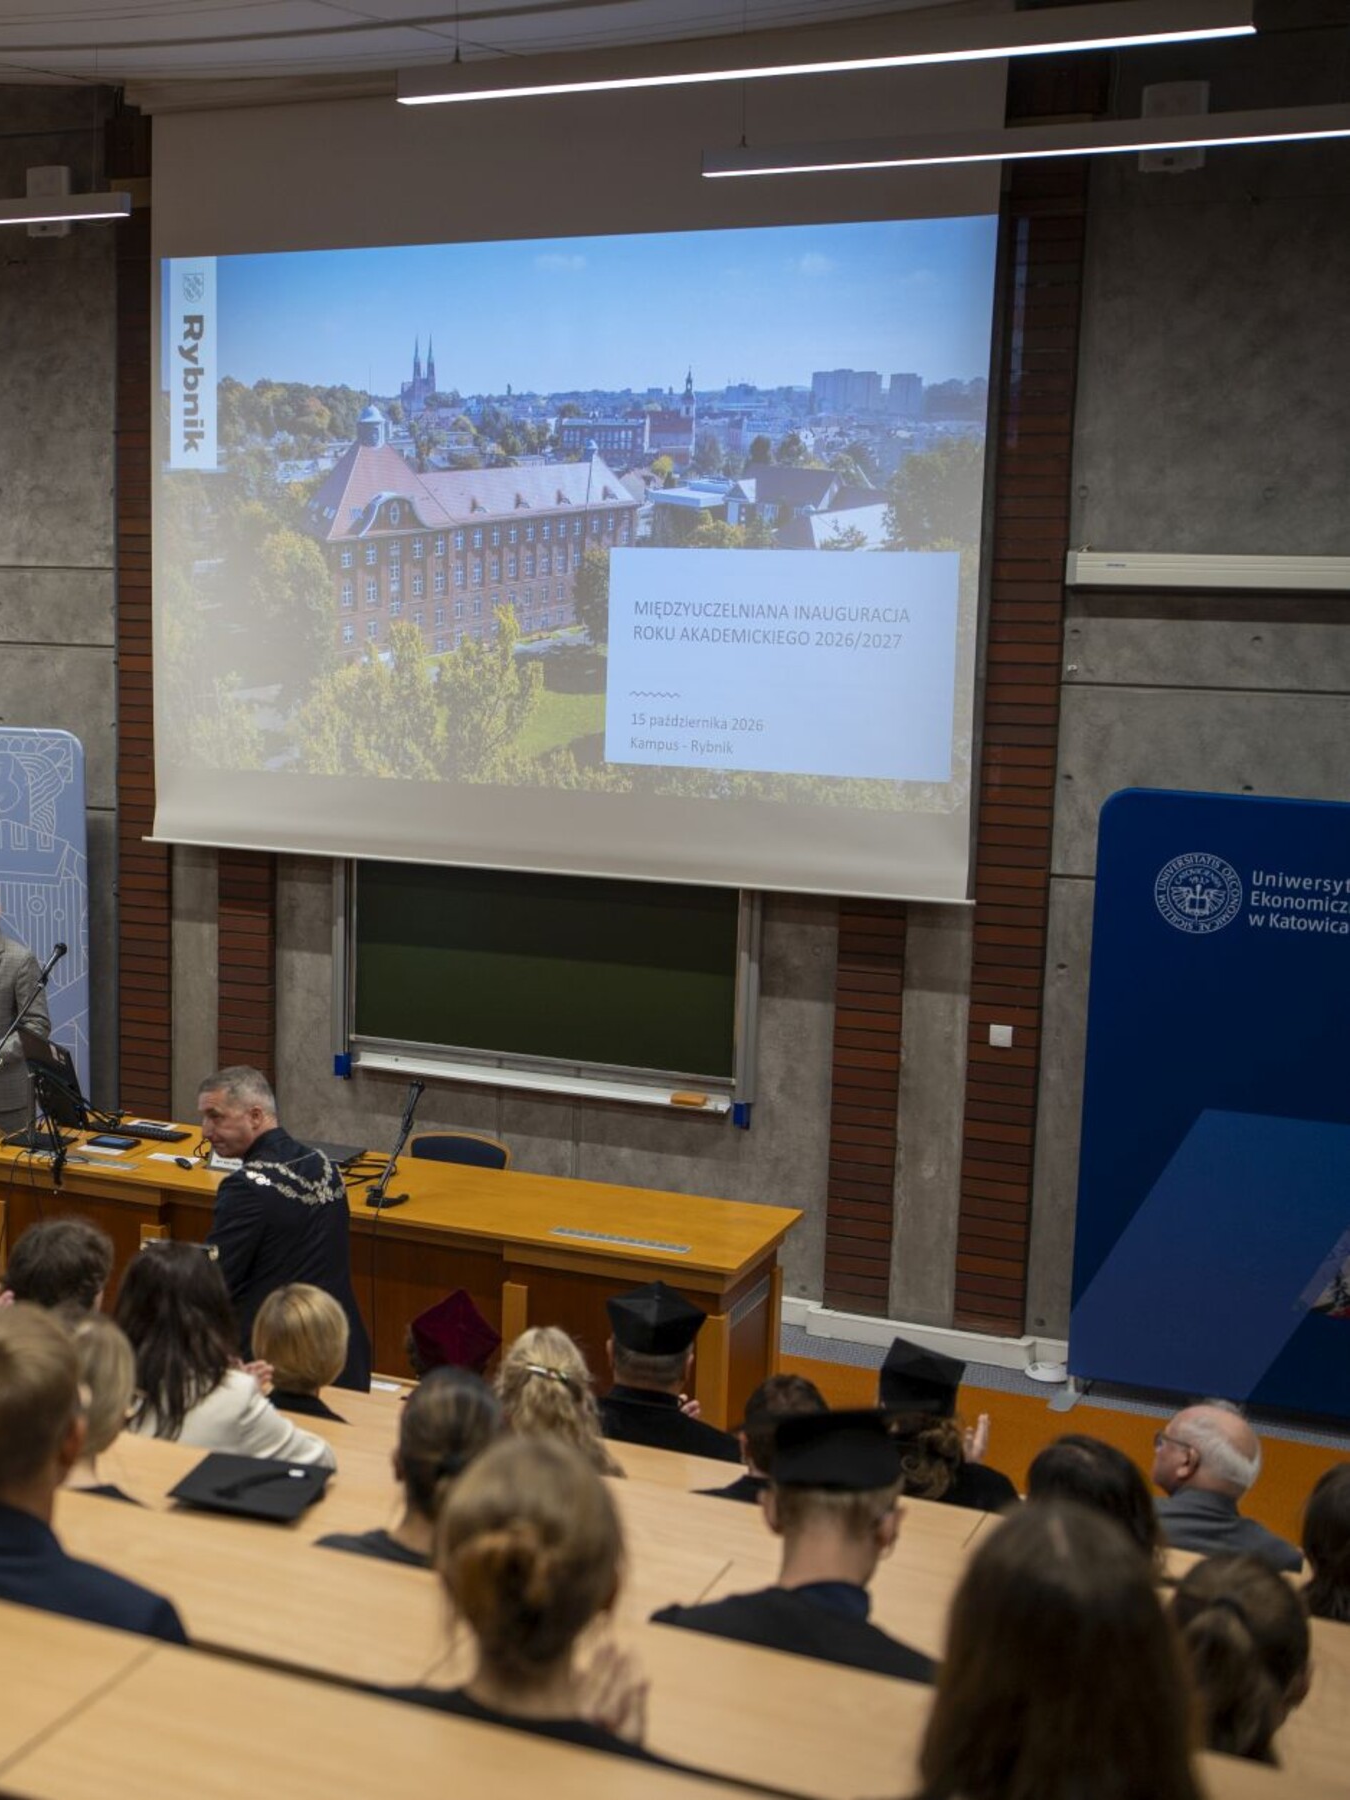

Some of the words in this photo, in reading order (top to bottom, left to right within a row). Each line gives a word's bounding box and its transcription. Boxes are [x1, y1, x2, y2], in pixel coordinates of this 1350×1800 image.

[178, 314, 204, 453] Rybnik
[634, 601, 789, 619] MIĘDZYUCZELNIANA
[795, 605, 911, 623] INAUGURACJA
[633, 625, 676, 641] ROKU
[680, 627, 810, 646] AKADEMICKIEGO
[815, 631, 903, 651] 2026/2027
[631, 713, 647, 726] 15
[650, 713, 728, 730] października
[731, 718, 765, 732] 2026
[630, 737, 679, 752] Kampus
[691, 740, 734, 755] Rybnik
[1251, 891, 1350, 914] Ekonomicz
[1249, 914, 1265, 927] w
[1269, 913, 1349, 934] Katowica
